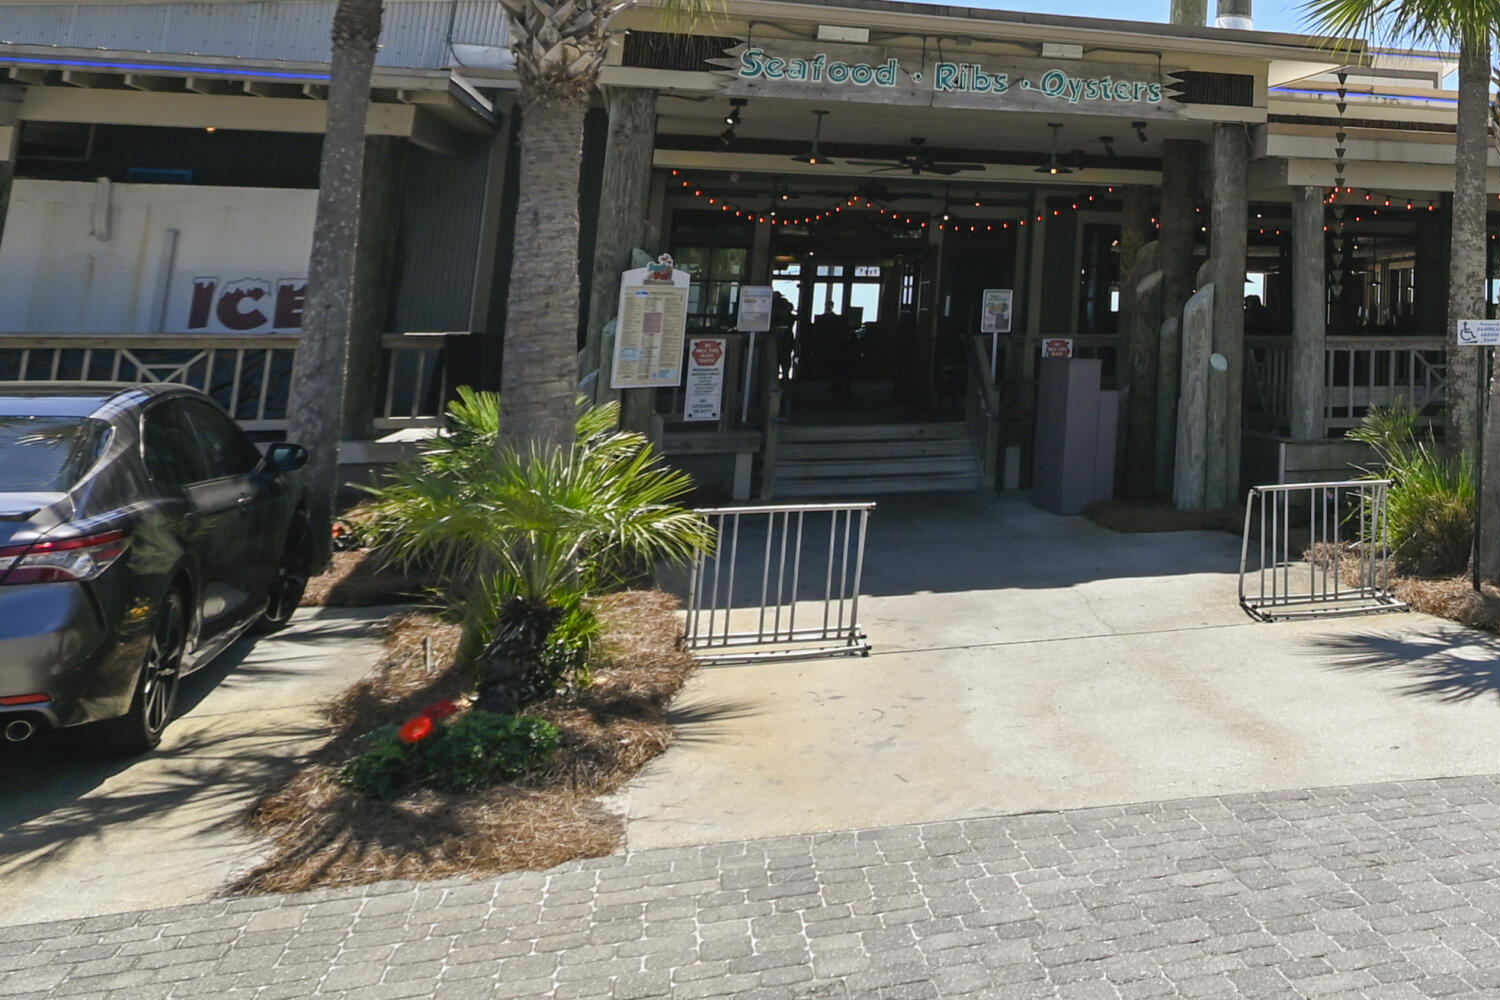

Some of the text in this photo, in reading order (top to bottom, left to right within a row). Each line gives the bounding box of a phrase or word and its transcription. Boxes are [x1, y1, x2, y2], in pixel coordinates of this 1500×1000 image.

[738, 47, 1162, 103] Seafood Ribs Oysters
[187, 275, 308, 331] ICE
